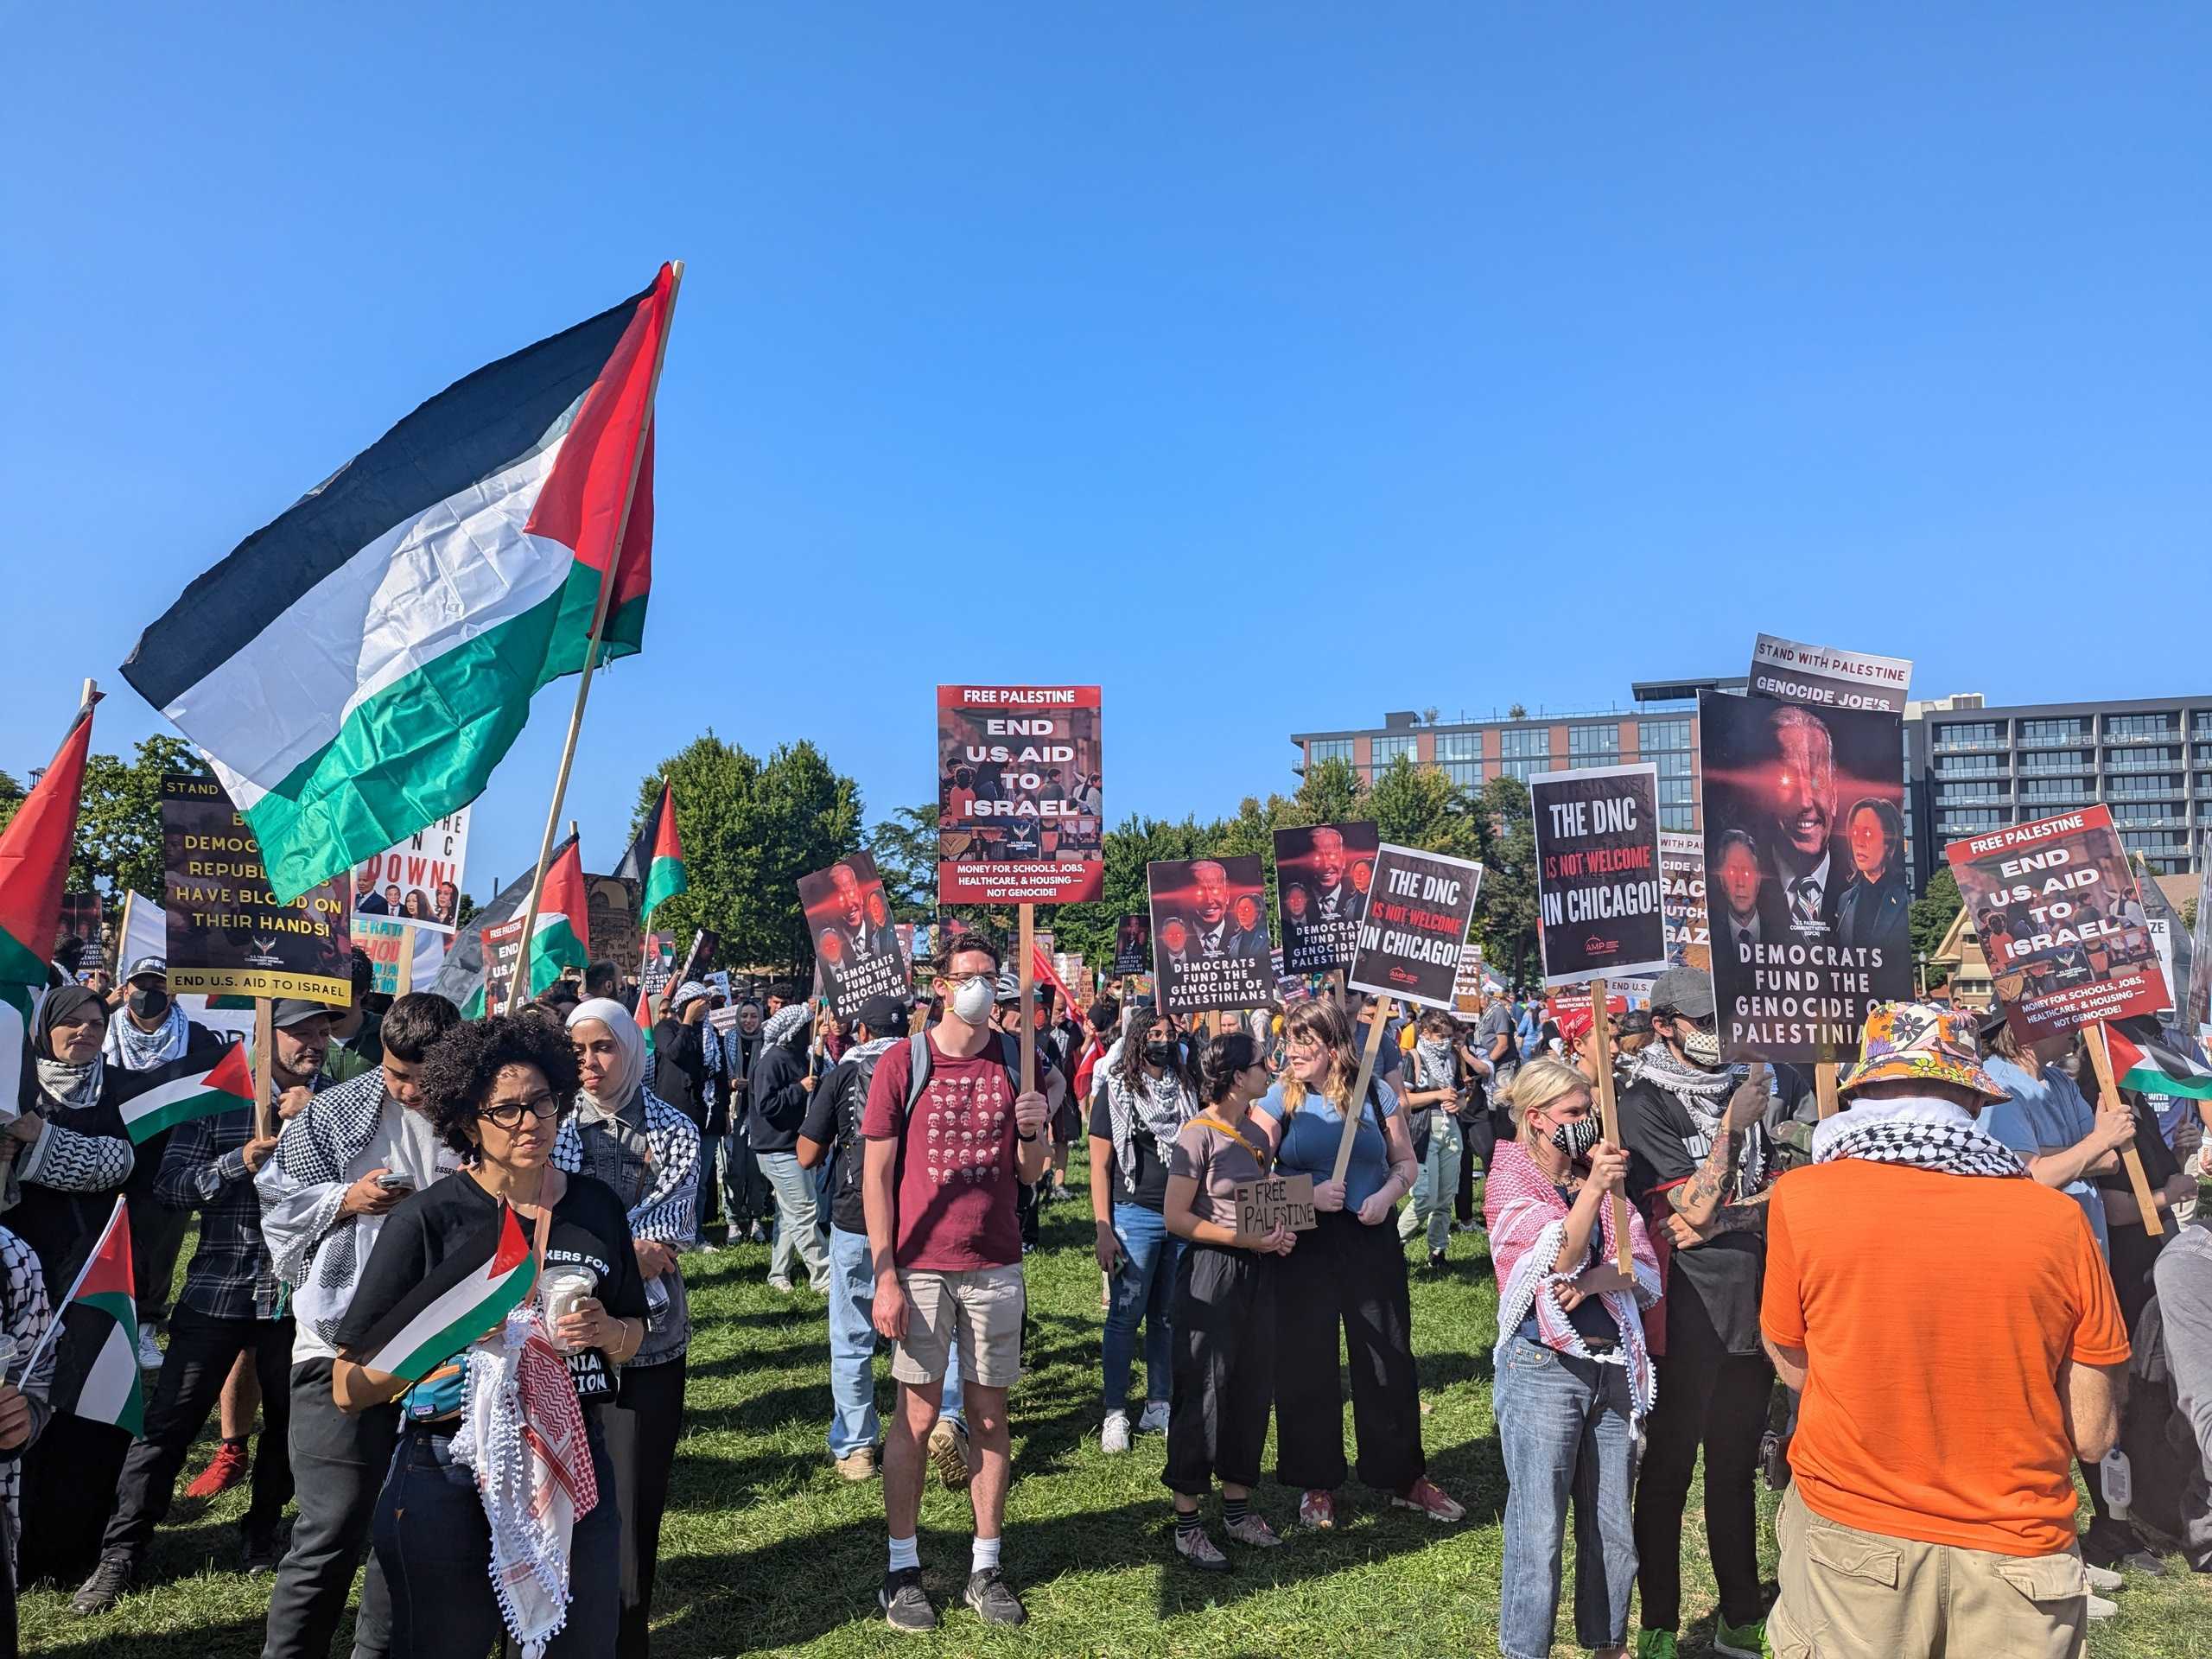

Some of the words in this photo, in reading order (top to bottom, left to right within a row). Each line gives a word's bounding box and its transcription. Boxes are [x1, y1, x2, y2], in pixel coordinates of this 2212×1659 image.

[1758, 643, 1794, 661] STAND
[1798, 652, 1829, 669] WITH
[1832, 659, 1905, 682] PALESTINE
[963, 690, 996, 702] FREE
[1000, 690, 1075, 703] PALESTINE
[1757, 676, 1834, 703] GENOCIDE
[1838, 693, 1891, 711] JOE'S
[987, 719, 1053, 735] END
[966, 746, 1013, 762] U.S.
[1017, 746, 1074, 762] AID
[167, 782, 219, 795] STAND
[1000, 773, 1040, 790] TO
[964, 800, 1077, 817] ISRAEL
[1549, 802, 1587, 839] THE
[1593, 796, 1636, 833] DNC
[432, 815, 462, 834] HE
[1969, 832, 2004, 855] FREE
[2005, 814, 2084, 846] PALESTINE
[184, 835, 257, 853] DEMOC
[1660, 838, 1684, 848] WITH
[366, 853, 455, 891] DOWN!
[957, 864, 990, 874] MONEY
[992, 864, 1011, 873] FOR
[1013, 864, 1058, 874] SCHOOLS,
[1059, 863, 1086, 874] JOBS,
[1545, 856, 1556, 879] IS
[1560, 853, 1583, 877] NOT
[1586, 845, 1651, 874] WELCOME
[1662, 861, 1691, 872] CIDE
[1999, 848, 2070, 879] END
[958, 876, 1019, 887] HEALTHCARE,
[1020, 876, 1028, 885] &
[1029, 875, 1071, 885] HOUSING
[1388, 868, 1420, 898] THE
[1422, 877, 1461, 906] DNC
[1989, 885, 2037, 907] U.S.
[2042, 868, 2100, 896] AID
[175, 887, 232, 901] HAVE
[239, 889, 308, 909] BLOD
[315, 898, 342, 914] ON
[1007, 888, 1057, 897] GENOCIDE!
[1543, 891, 1563, 927] IN
[1567, 880, 1659, 924] CHICAGO!
[1663, 905, 1707, 918] UTCH
[2029, 901, 2072, 924] TO
[192, 912, 252, 928] THEIR
[259, 916, 330, 938] HANDS!
[1296, 920, 1362, 936] DEMOCRAT
[1370, 901, 1383, 918] IS
[1384, 903, 1408, 924] NOT
[1409, 909, 1464, 935] WELCOME
[1304, 934, 1335, 945] FUND
[1340, 931, 1360, 942] TH
[1665, 925, 1709, 945] GAZ
[2004, 918, 2120, 959] ISRAEL
[499, 942, 519, 958] END
[1294, 941, 1355, 957] GENOCIDE
[1360, 925, 1381, 950] IN
[1382, 930, 1460, 969] CHICAGO!
[1586, 942, 1605, 952] AMP
[1738, 943, 1884, 968] DEMOCRATS
[836, 954, 894, 982] DEMOCRATS
[1174, 957, 1255, 974] DEMOCRATS
[1292, 952, 1354, 968] PALESTINI
[175, 976, 204, 986] END
[211, 976, 238, 986] U.S.
[243, 977, 266, 988] AID
[272, 979, 292, 990] TO
[298, 981, 345, 997] ISRAEL
[845, 975, 872, 991] FUND
[874, 966, 892, 980] THE
[1183, 972, 1218, 983] FUND
[1224, 969, 1248, 980] THE
[1755, 969, 1819, 991] FUND
[1830, 972, 1869, 993] THE
[505, 981, 512, 993] T
[837, 980, 888, 1004] GENOCIDE
[891, 974, 902, 986] OF
[1171, 981, 1240, 995] GENOCIDE
[1245, 979, 1262, 989] OF
[1452, 987, 1477, 995] AZA
[1611, 982, 1629, 991] END
[1631, 982, 1649, 992] U.S.
[2021, 999, 2049, 1014] MONEY
[2050, 994, 2068, 1006] FOR
[2069, 982, 2117, 1000] SCHOOLS,
[2118, 976, 2145, 988] JOBS,
[1169, 989, 1267, 1007] PALESTINIANS
[1735, 995, 1854, 1019] GENOCIDE
[1866, 998, 1895, 1015] O
[2026, 1003, 2079, 1024] HEALTHCARE,
[2081, 1001, 2088, 1009] &
[2089, 990, 2133, 1007] HOUSING
[2053, 1018, 2071, 1029] NOT
[2071, 1004, 2122, 1023] GENOCIDE!
[1732, 1021, 1864, 1045] PALESTINI
[435, 1166, 456, 1175] ESSEN
[1255, 1180, 1287, 1205] FREE
[1244, 1202, 1314, 1234] PALESTINE
[584, 1255, 610, 1277] FOR
